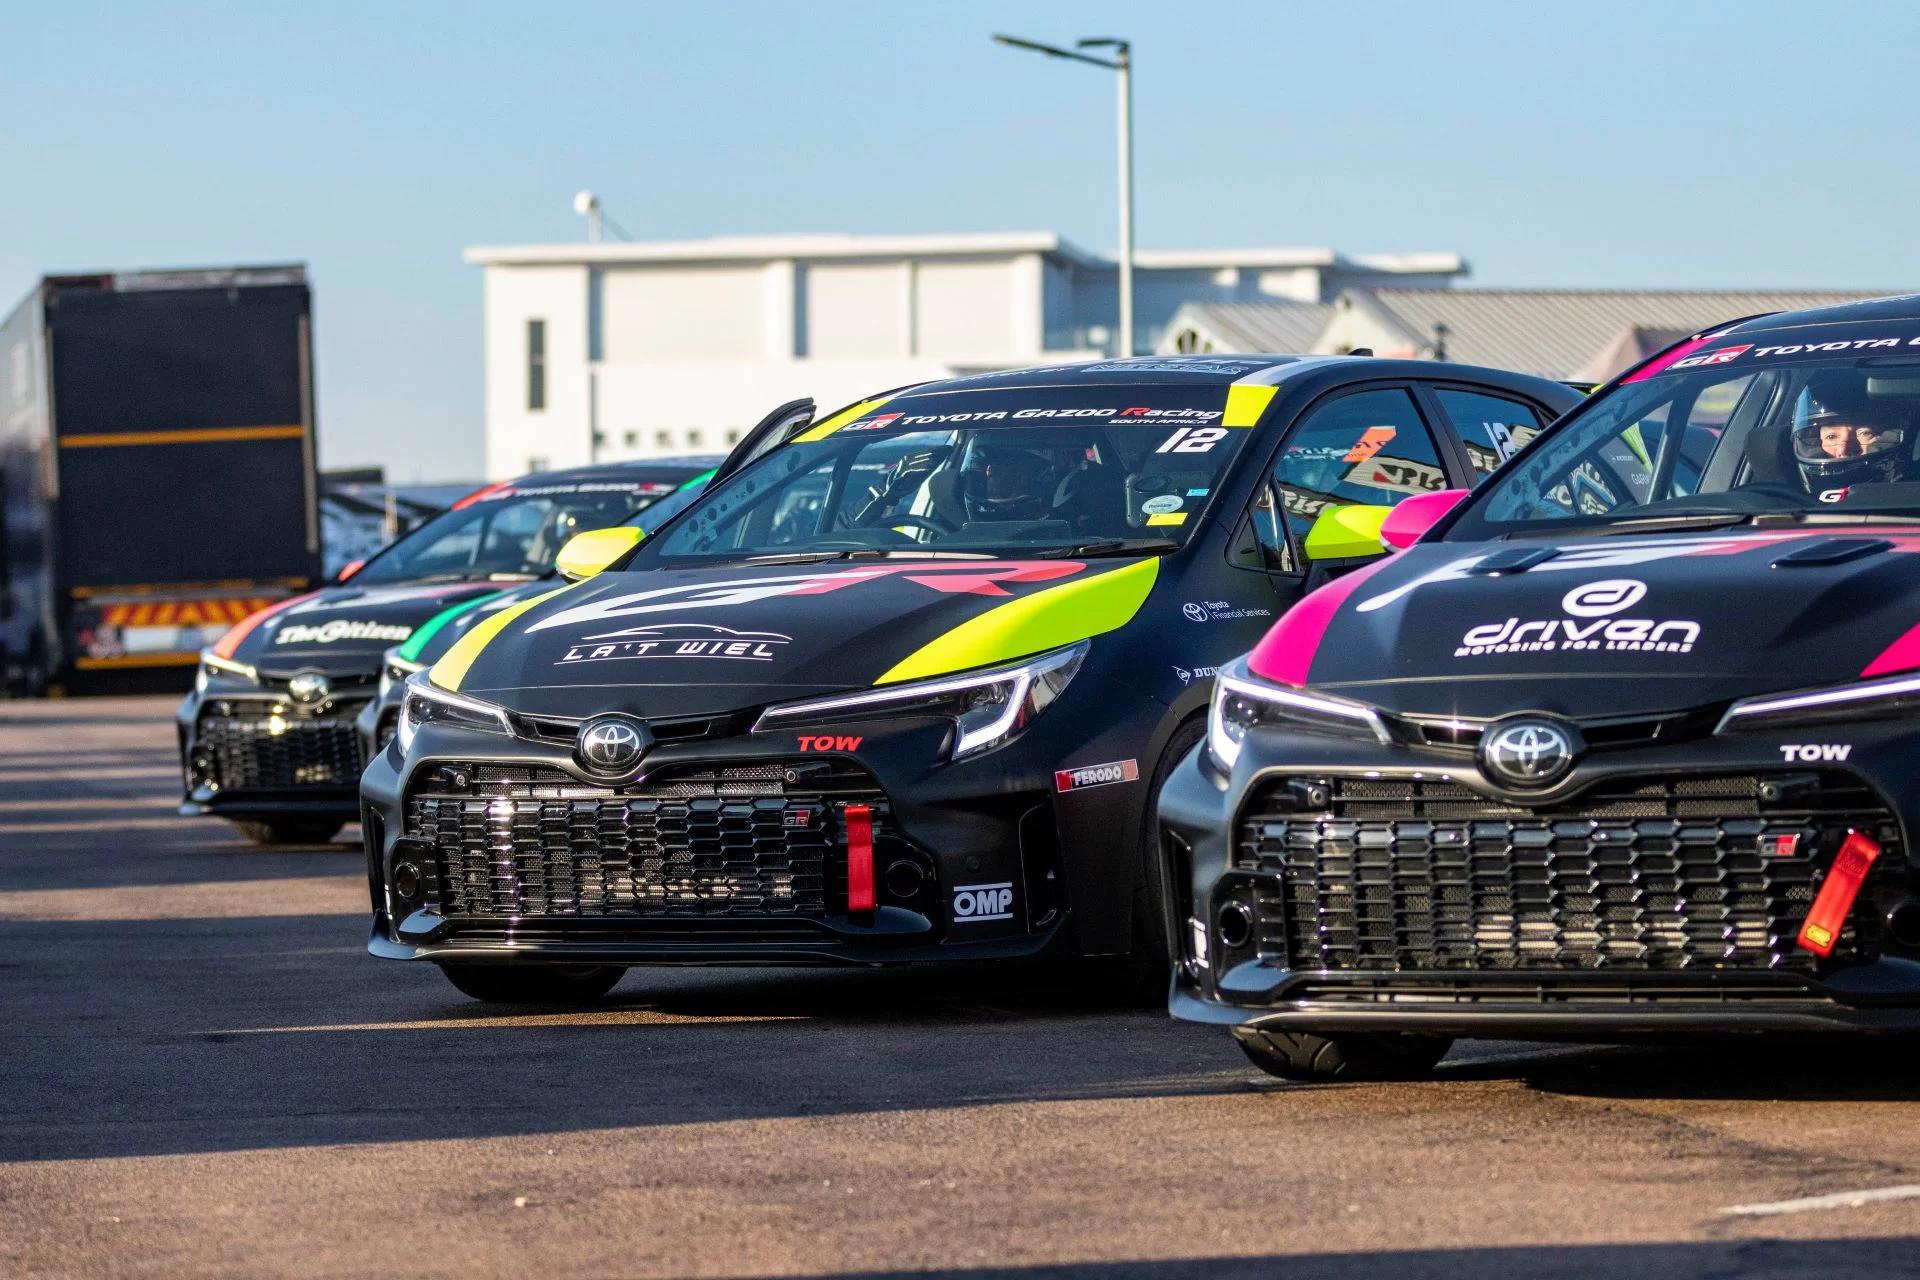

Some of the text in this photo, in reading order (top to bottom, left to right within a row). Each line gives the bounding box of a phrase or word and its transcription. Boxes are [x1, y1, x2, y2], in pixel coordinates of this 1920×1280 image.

[1668, 350, 1746, 368] GR
[1754, 338, 1901, 357] TOYOTA
[841, 407, 1223, 432] GR TOYOTA GAZOO Racing
[1155, 427, 1229, 453] 12
[1204, 601, 1230, 611] Toyota
[1213, 608, 1271, 619] Financial Services
[1463, 617, 1701, 648] driven
[676, 642, 774, 657] WIEL
[1453, 640, 1693, 657] MOTORING FOR LEADERS
[1193, 666, 1220, 678] DUN
[797, 736, 863, 752] TOW
[1780, 744, 1852, 762] TOW
[1073, 765, 1123, 787] FERODO
[953, 892, 1013, 917] OMP
